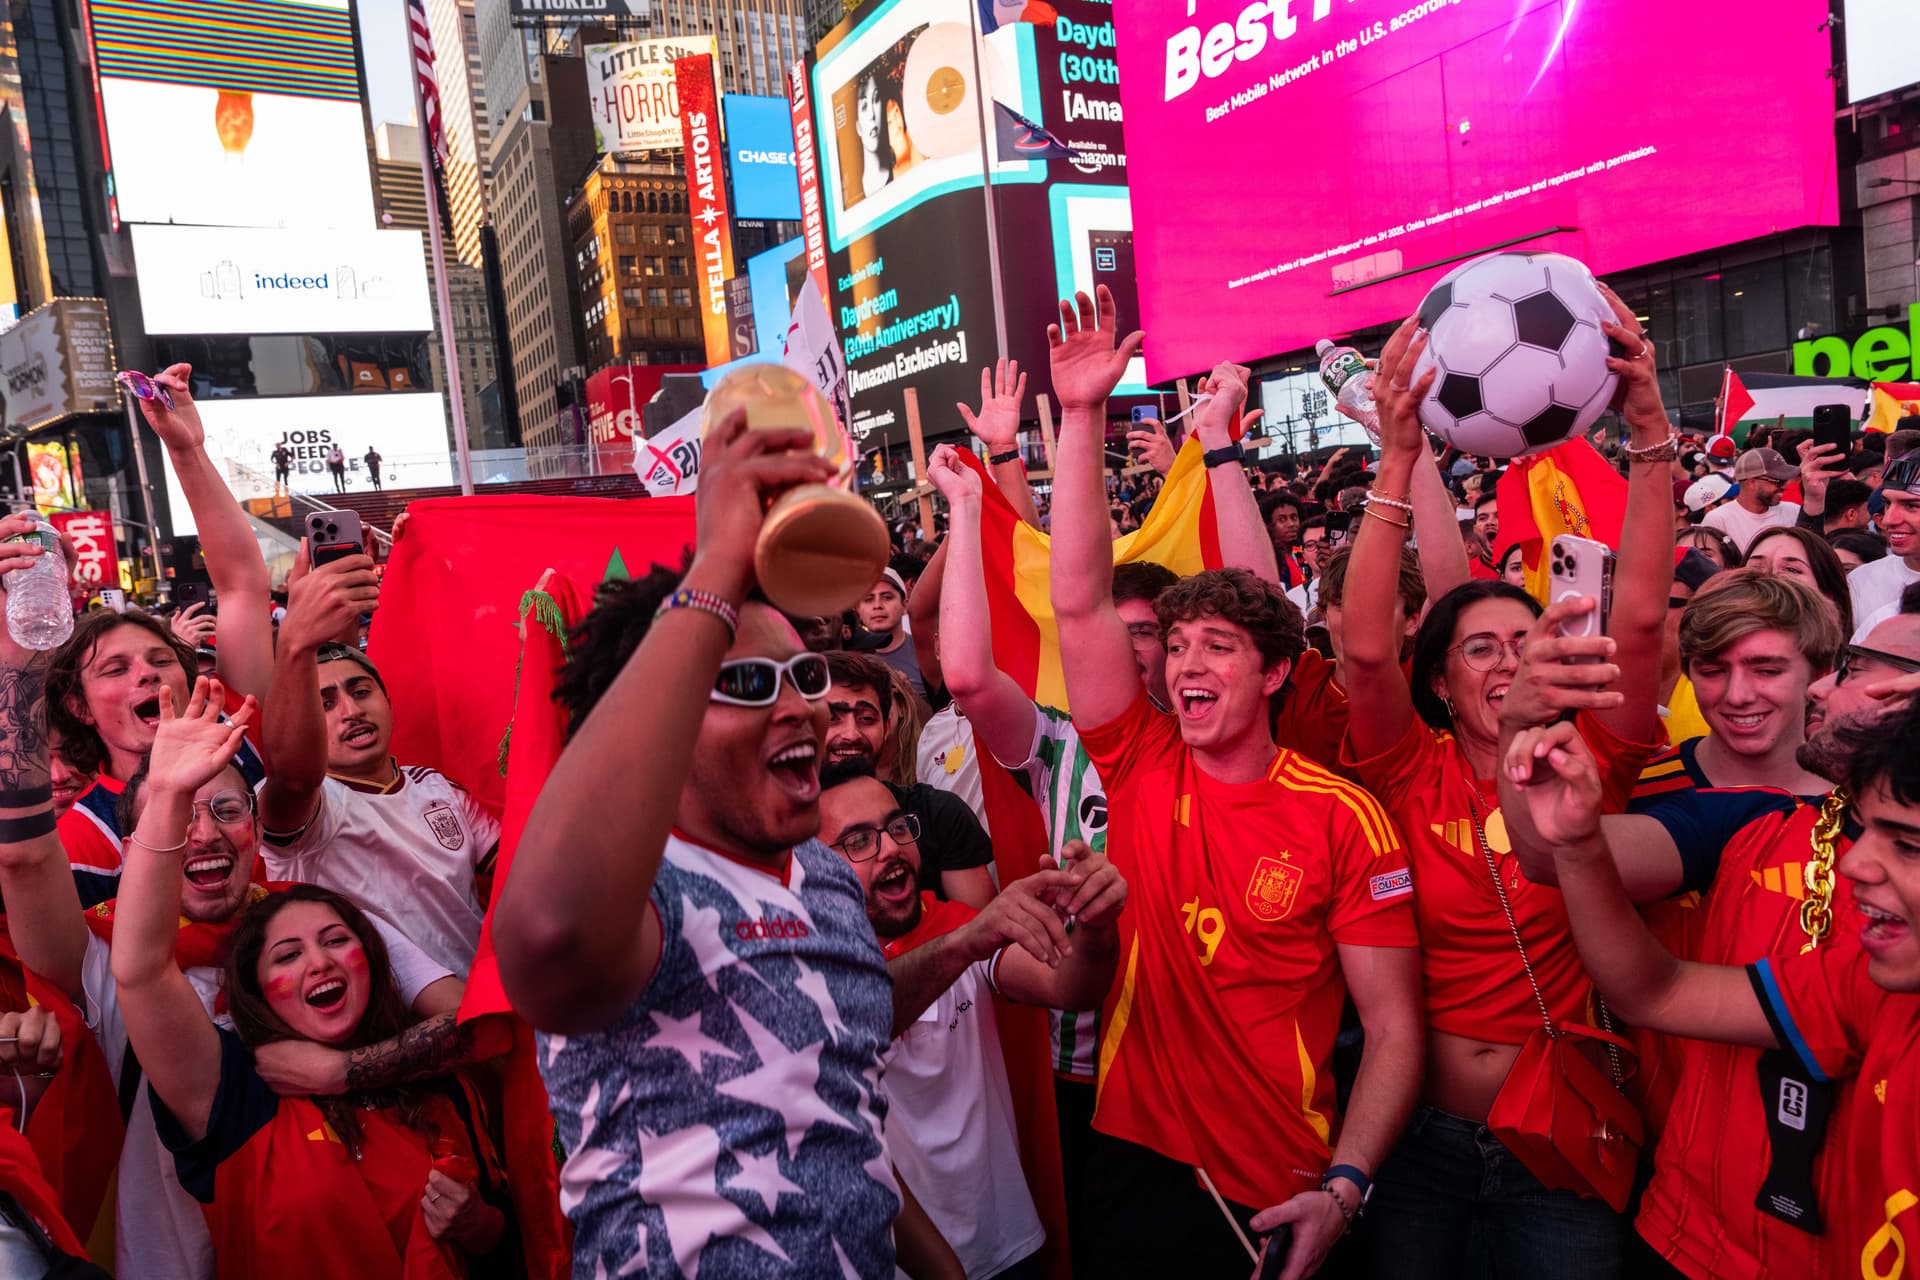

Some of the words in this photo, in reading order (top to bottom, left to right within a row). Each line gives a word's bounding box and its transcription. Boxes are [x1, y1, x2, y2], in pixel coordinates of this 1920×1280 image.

[601, 45, 659, 81] LITTLE
[1060, 52, 1120, 84] (30th
[1165, 0, 1297, 103] Best
[1206, 101, 1229, 123] Best
[1231, 81, 1268, 110] Mobile
[1269, 55, 1320, 90] Network
[1322, 44, 1334, 65] in
[1335, 38, 1357, 58] the
[1360, 21, 1388, 46] U.S.
[690, 111, 717, 201] ARTOIS
[738, 150, 788, 165] CHASE
[796, 118, 816, 187] COME
[738, 220, 765, 228] KEVANI
[803, 185, 825, 271] INSIDE!
[1270, 266, 1277, 276] by
[1293, 258, 1299, 269] of
[1464, 200, 1482, 214] used
[1482, 193, 1504, 208] under
[1504, 185, 1531, 201] license
[1531, 179, 1547, 193] and
[1548, 166, 1586, 187] reprinted
[1586, 159, 1606, 175] with
[1606, 144, 1657, 170] permission.
[255, 273, 328, 289] indeed
[703, 227, 728, 316] STELLA
[838, 266, 867, 292] Exclusive
[866, 256, 884, 277] Vinyl
[840, 287, 898, 330] Daydream
[875, 293, 961, 350] Anniversary)
[847, 358, 898, 398] [Amazon
[896, 330, 968, 379] Exclusive]
[281, 429, 332, 445] JOBS
[591, 411, 616, 444] FIVE
[66, 516, 107, 583] tkts
[735, 912, 809, 941] adidas
[1180, 895, 1226, 967] 19
